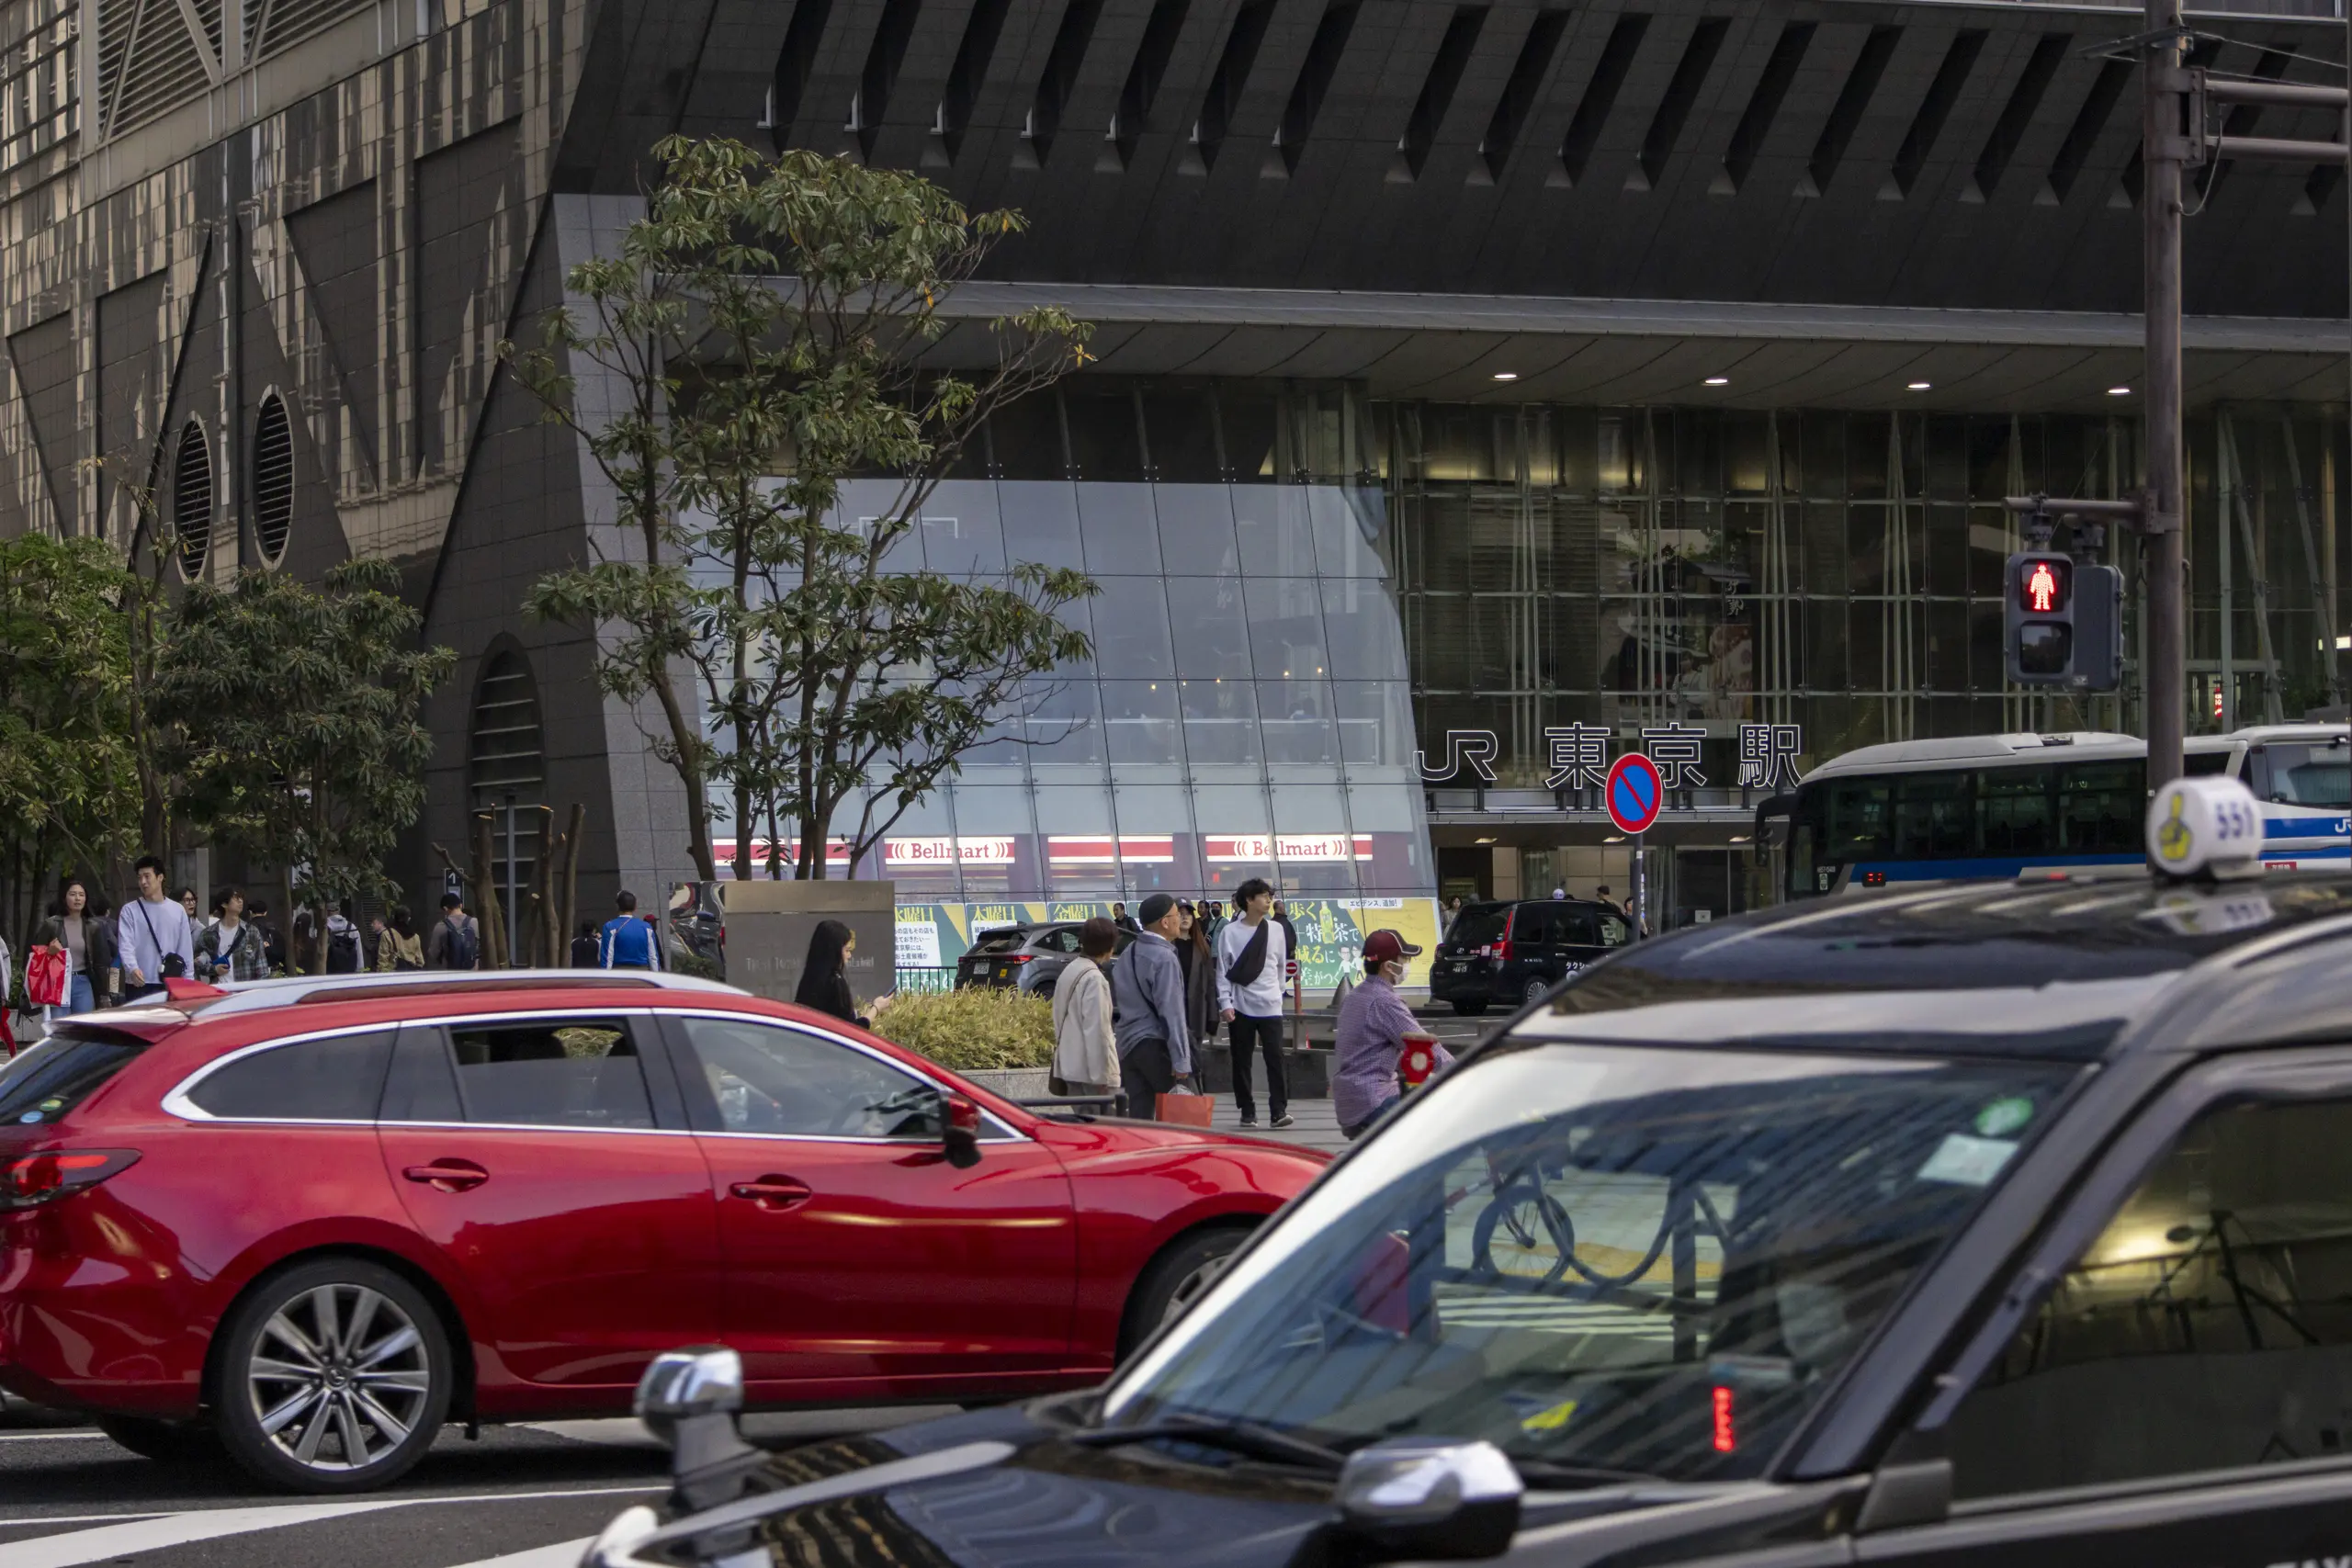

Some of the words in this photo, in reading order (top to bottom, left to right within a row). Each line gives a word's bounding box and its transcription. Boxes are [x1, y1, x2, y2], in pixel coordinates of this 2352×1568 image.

[1412, 729, 1498, 781] JR
[1544, 721, 1804, 789] 東京駅
[2216, 803, 2254, 840] 551
[910, 842, 989, 859] Bellmart
[1252, 840, 1328, 856] Belmart
[448, 872, 456, 885] 1
[970, 905, 1016, 924] 木曜日
[1053, 904, 1096, 920] 金曜日
[1289, 902, 1317, 921] 歩く
